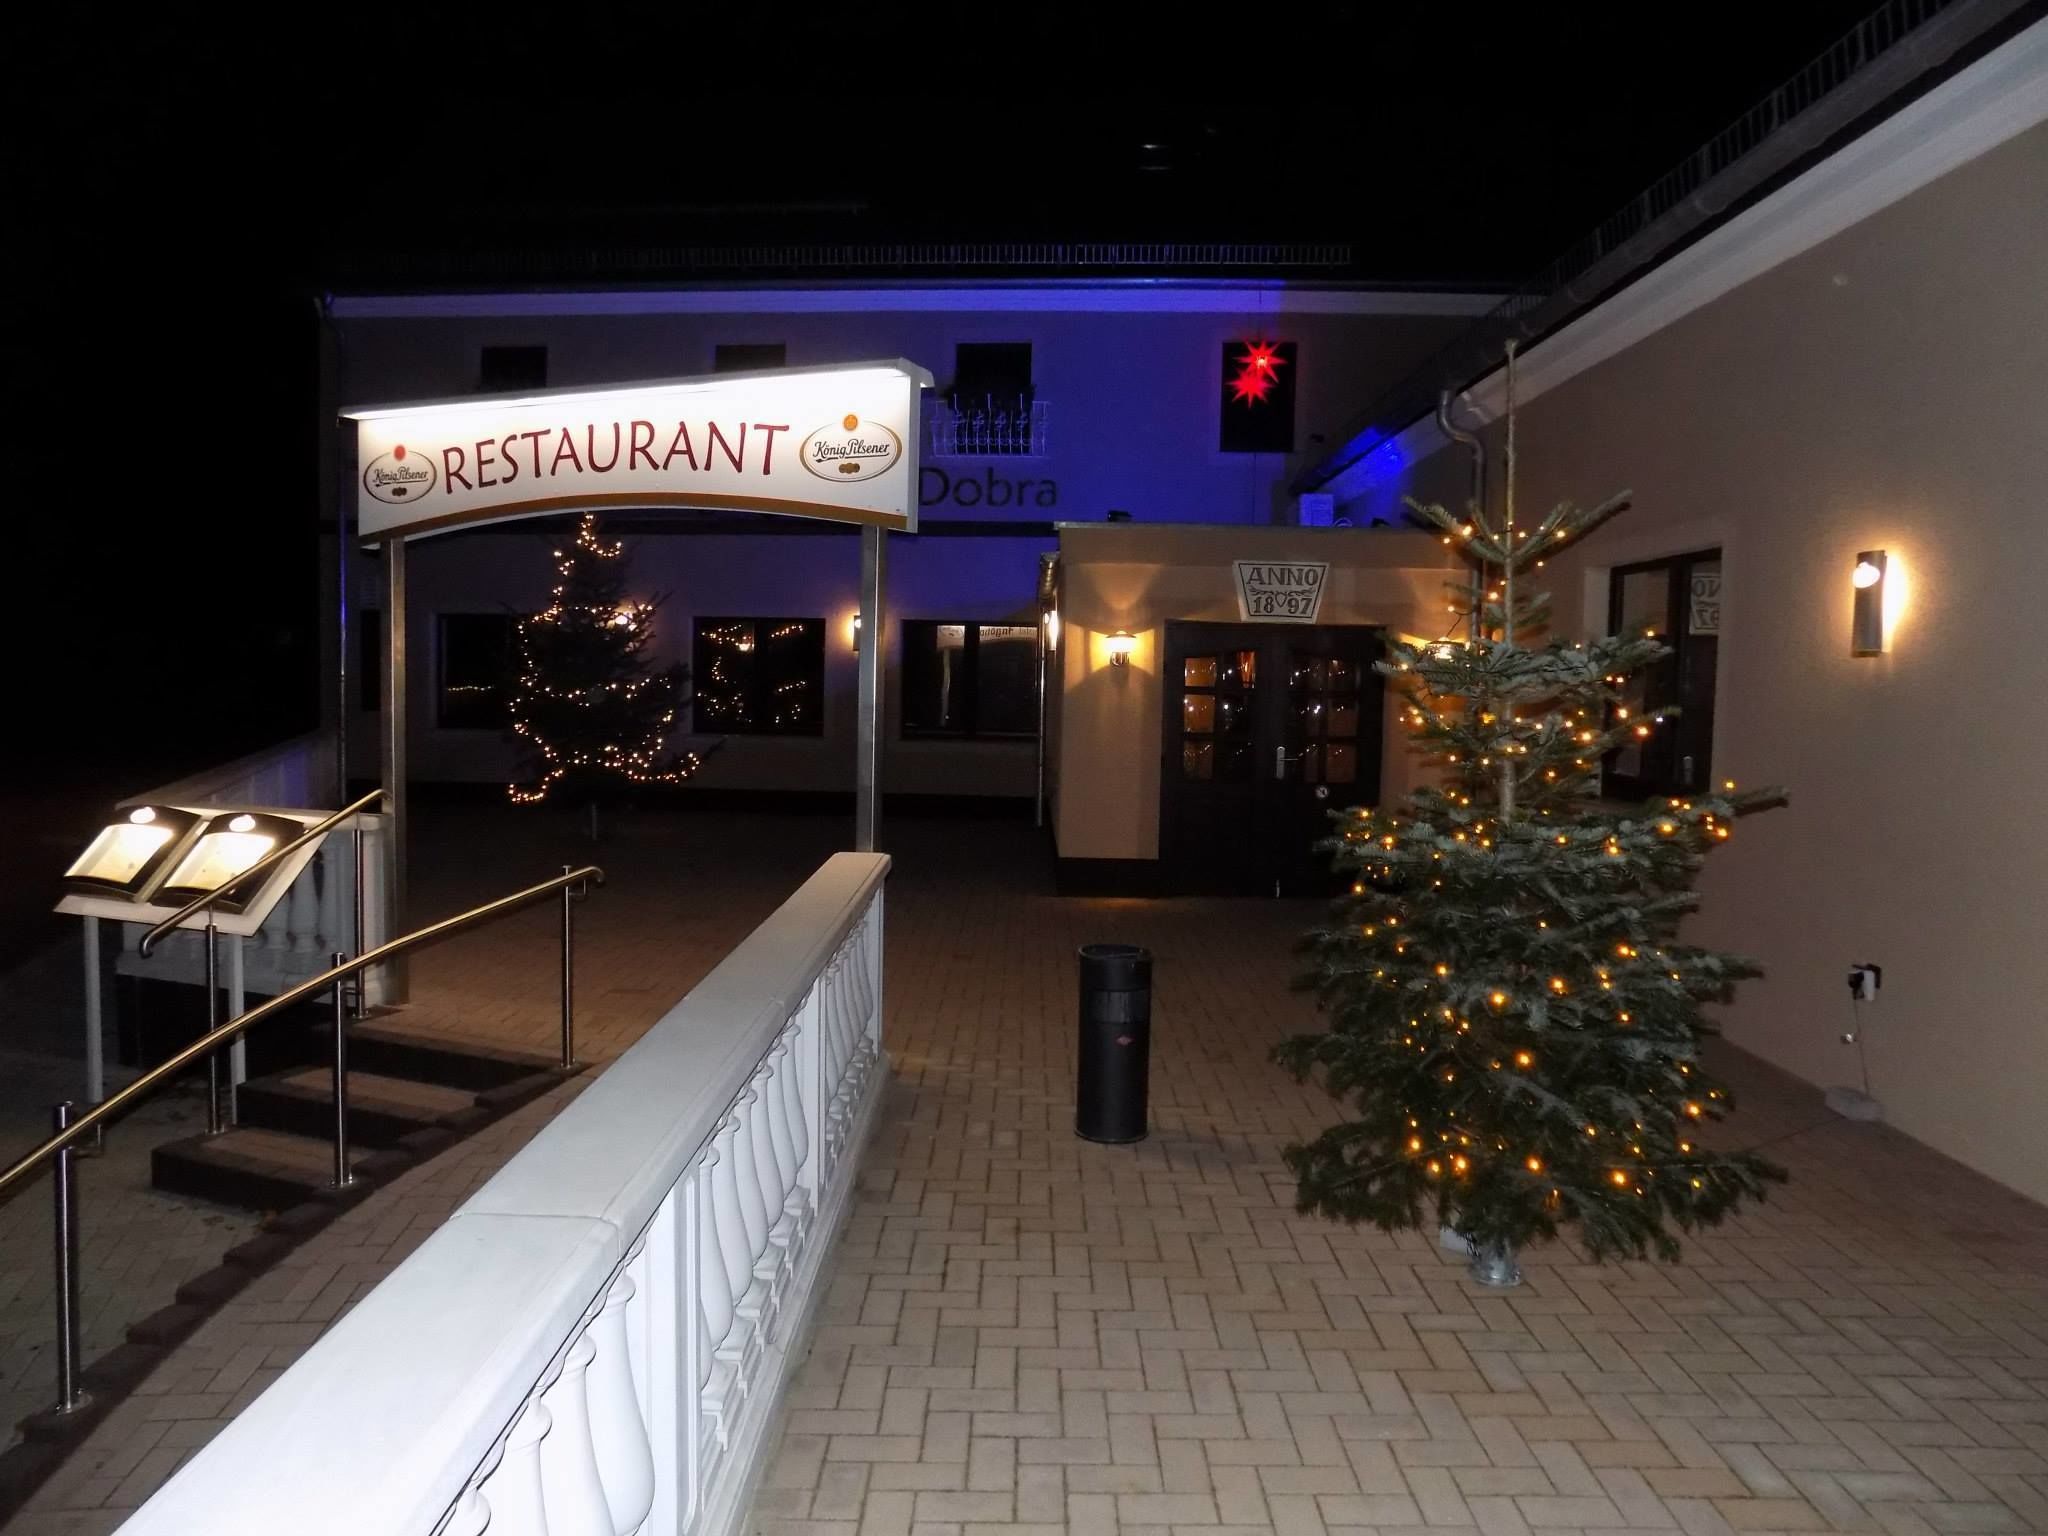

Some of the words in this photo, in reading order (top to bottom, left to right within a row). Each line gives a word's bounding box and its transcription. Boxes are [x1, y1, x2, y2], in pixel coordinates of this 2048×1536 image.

[442, 420, 790, 495] RESTAURANT
[813, 440, 848, 460] König
[846, 438, 890, 456] Pilsener
[397, 465, 429, 481] Pilsener
[919, 467, 1057, 507] Dobra
[1246, 567, 1319, 586] ANNO
